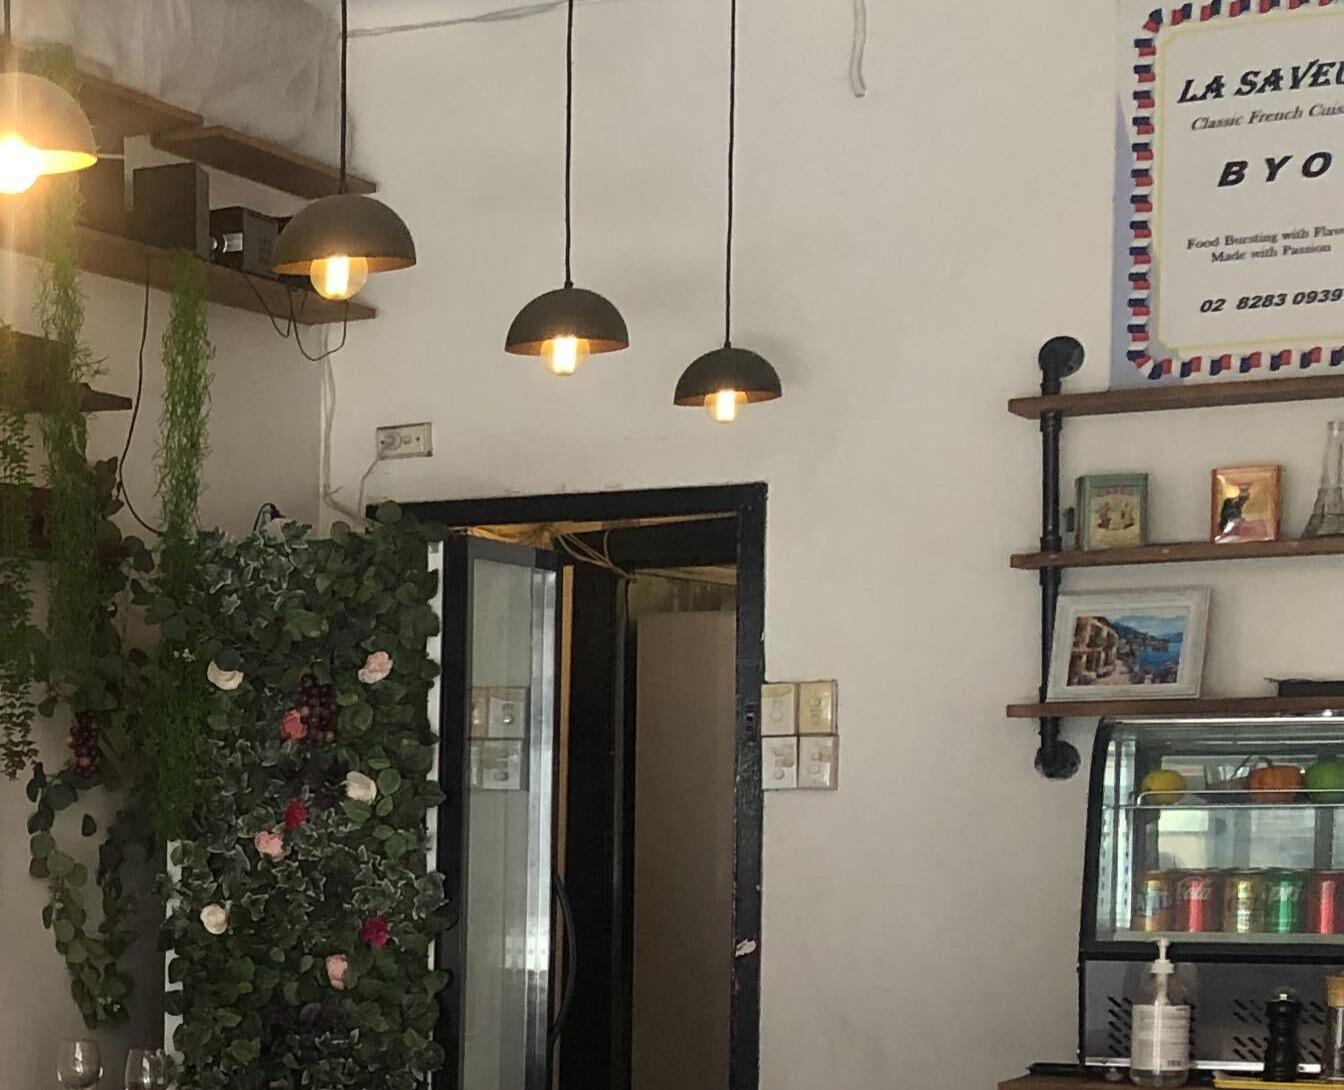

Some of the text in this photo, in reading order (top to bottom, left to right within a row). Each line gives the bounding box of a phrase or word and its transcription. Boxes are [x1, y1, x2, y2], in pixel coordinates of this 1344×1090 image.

[1177, 75, 1224, 103] LA
[1192, 116, 1243, 131] Classic
[1248, 106, 1303, 124] French
[1187, 237, 1219, 249] Food
[1224, 234, 1277, 246] Bursting
[1282, 229, 1309, 240] with
[1211, 245, 1331, 262] Made with Passion
[1200, 288, 1344, 313] 02 8283 0939
